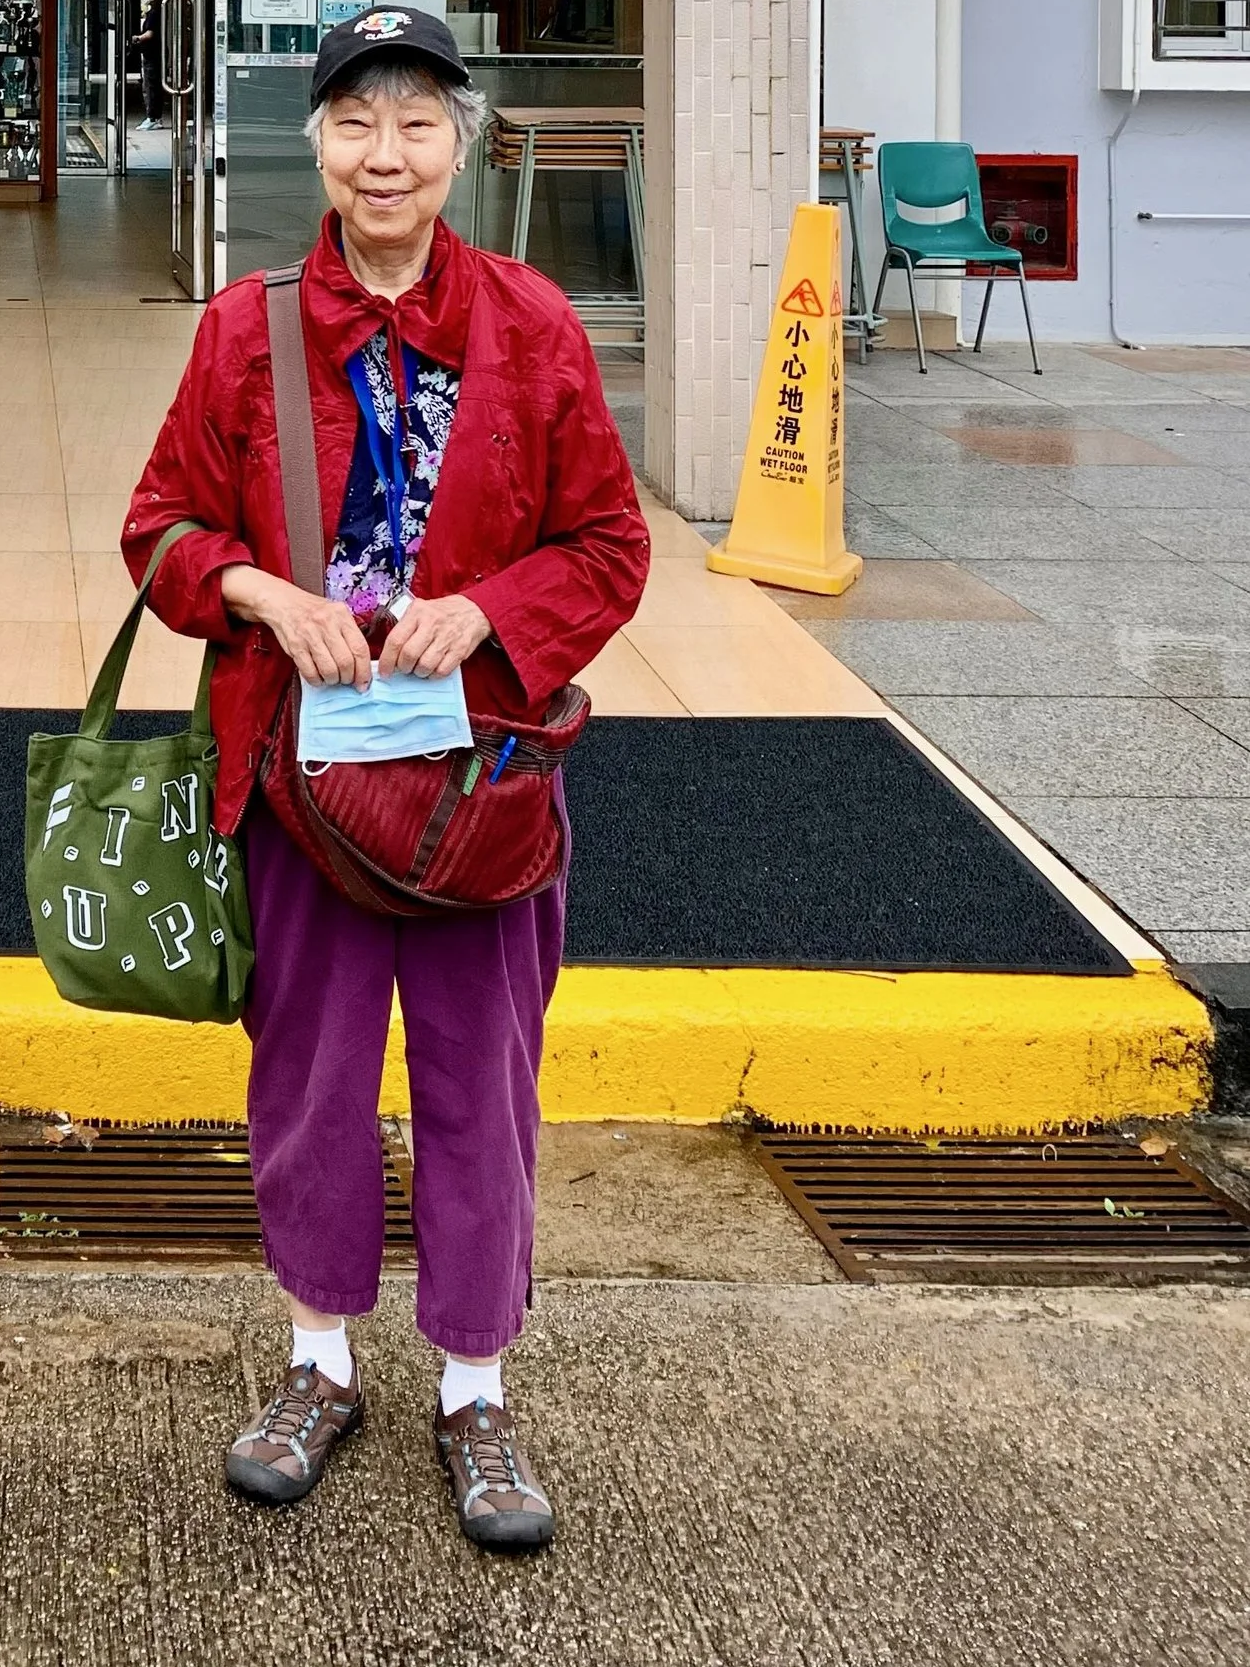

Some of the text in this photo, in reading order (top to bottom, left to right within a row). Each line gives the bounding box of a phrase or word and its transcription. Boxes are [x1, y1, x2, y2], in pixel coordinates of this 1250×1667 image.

[774, 320, 810, 446] 小心地滑
[765, 445, 805, 461] CAUTION
[760, 457, 808, 474] WET FLOOR
